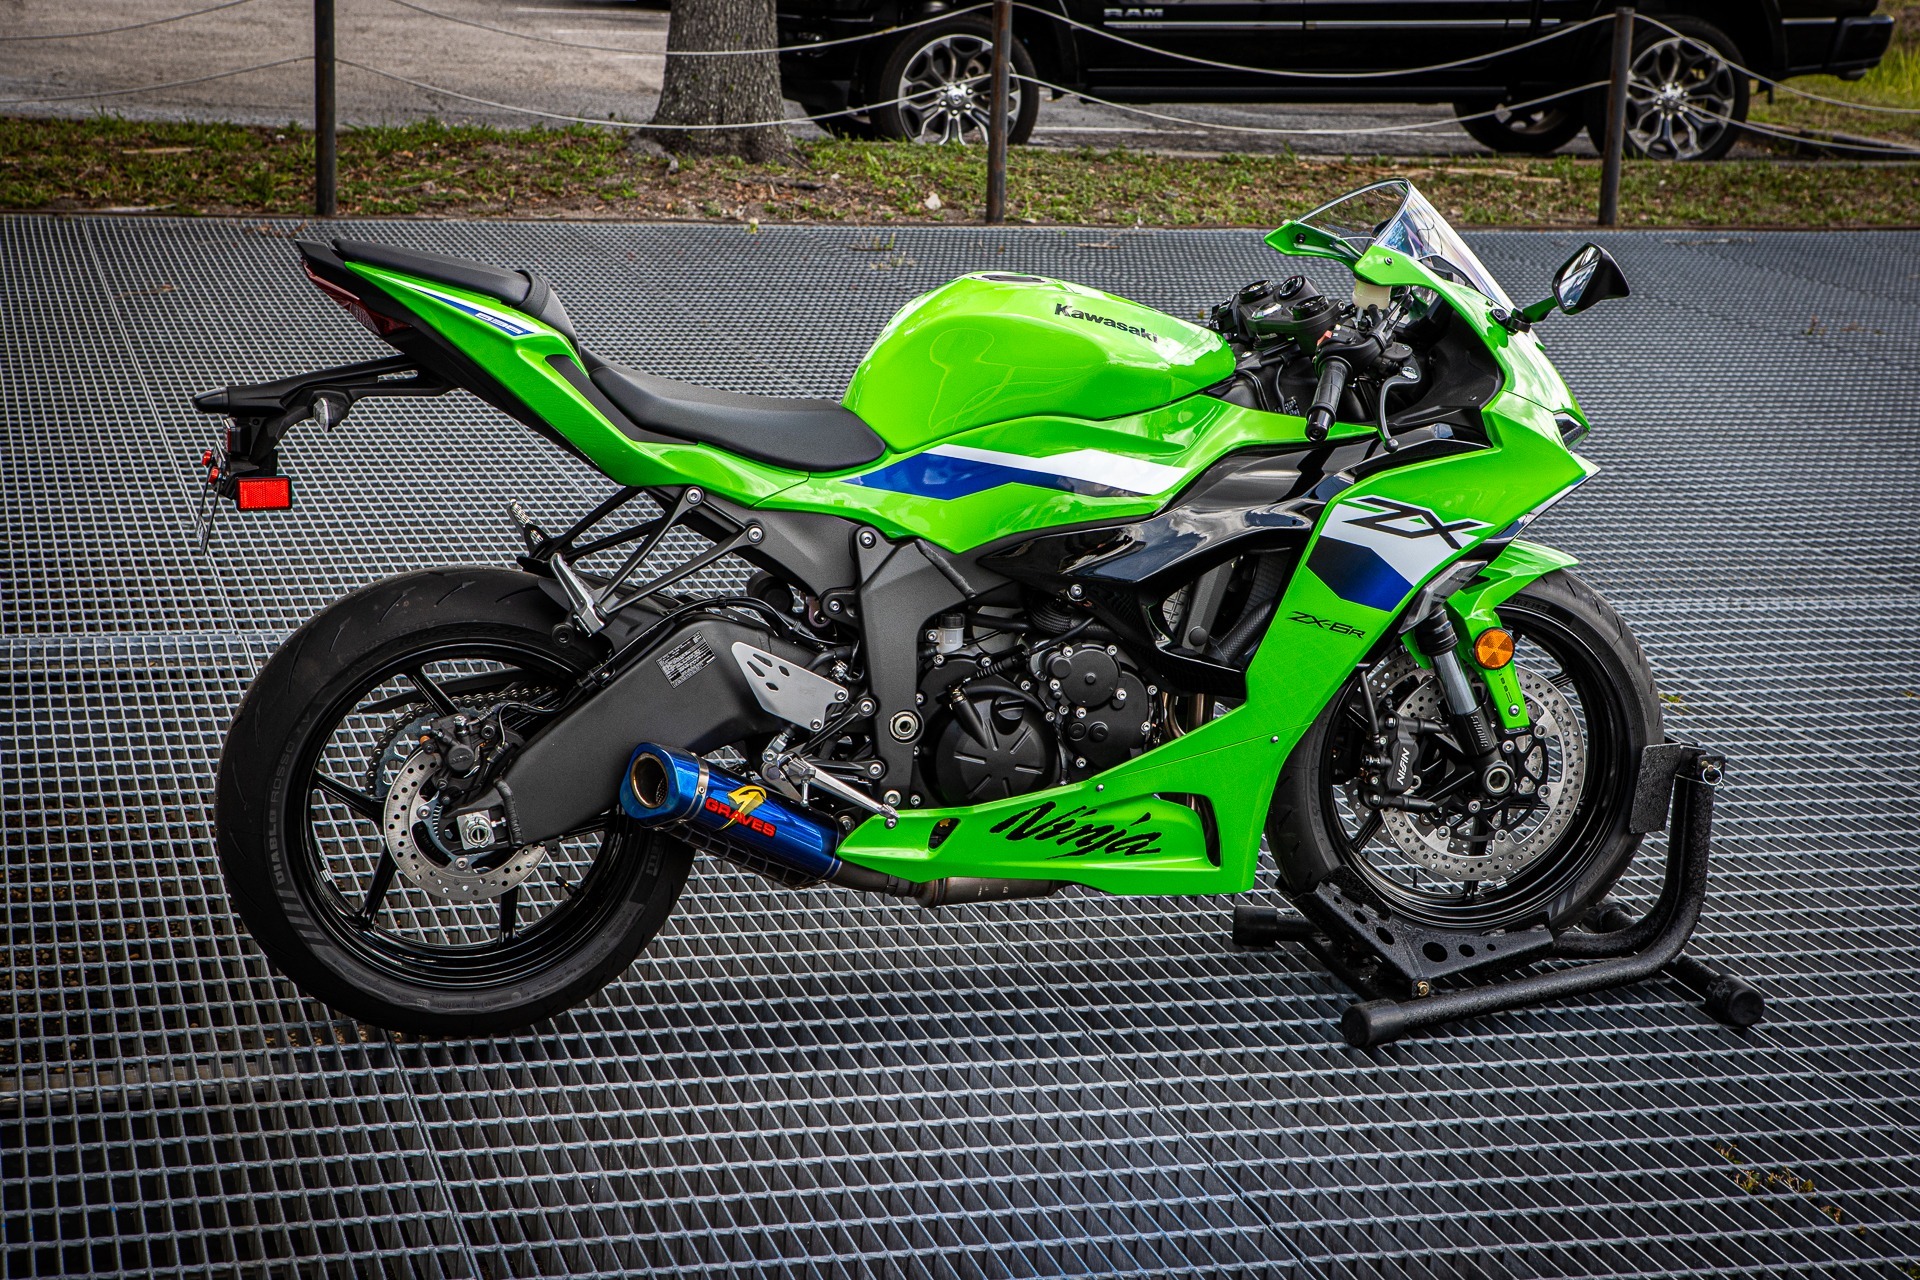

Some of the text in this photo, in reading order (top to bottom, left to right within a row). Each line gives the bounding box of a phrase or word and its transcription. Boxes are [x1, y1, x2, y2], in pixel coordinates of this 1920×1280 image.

[1104, 8, 1164, 17] RAM
[1055, 303, 1158, 343] Kawasaki
[1341, 497, 1483, 551] ZX
[1287, 611, 1366, 639] ZX-6R
[270, 742, 295, 803] ROSSO
[1396, 747, 1410, 786] NISSIN
[704, 797, 777, 839] GRAVES
[989, 801, 1163, 860] Ninja
[269, 809, 286, 885] DIABLO
